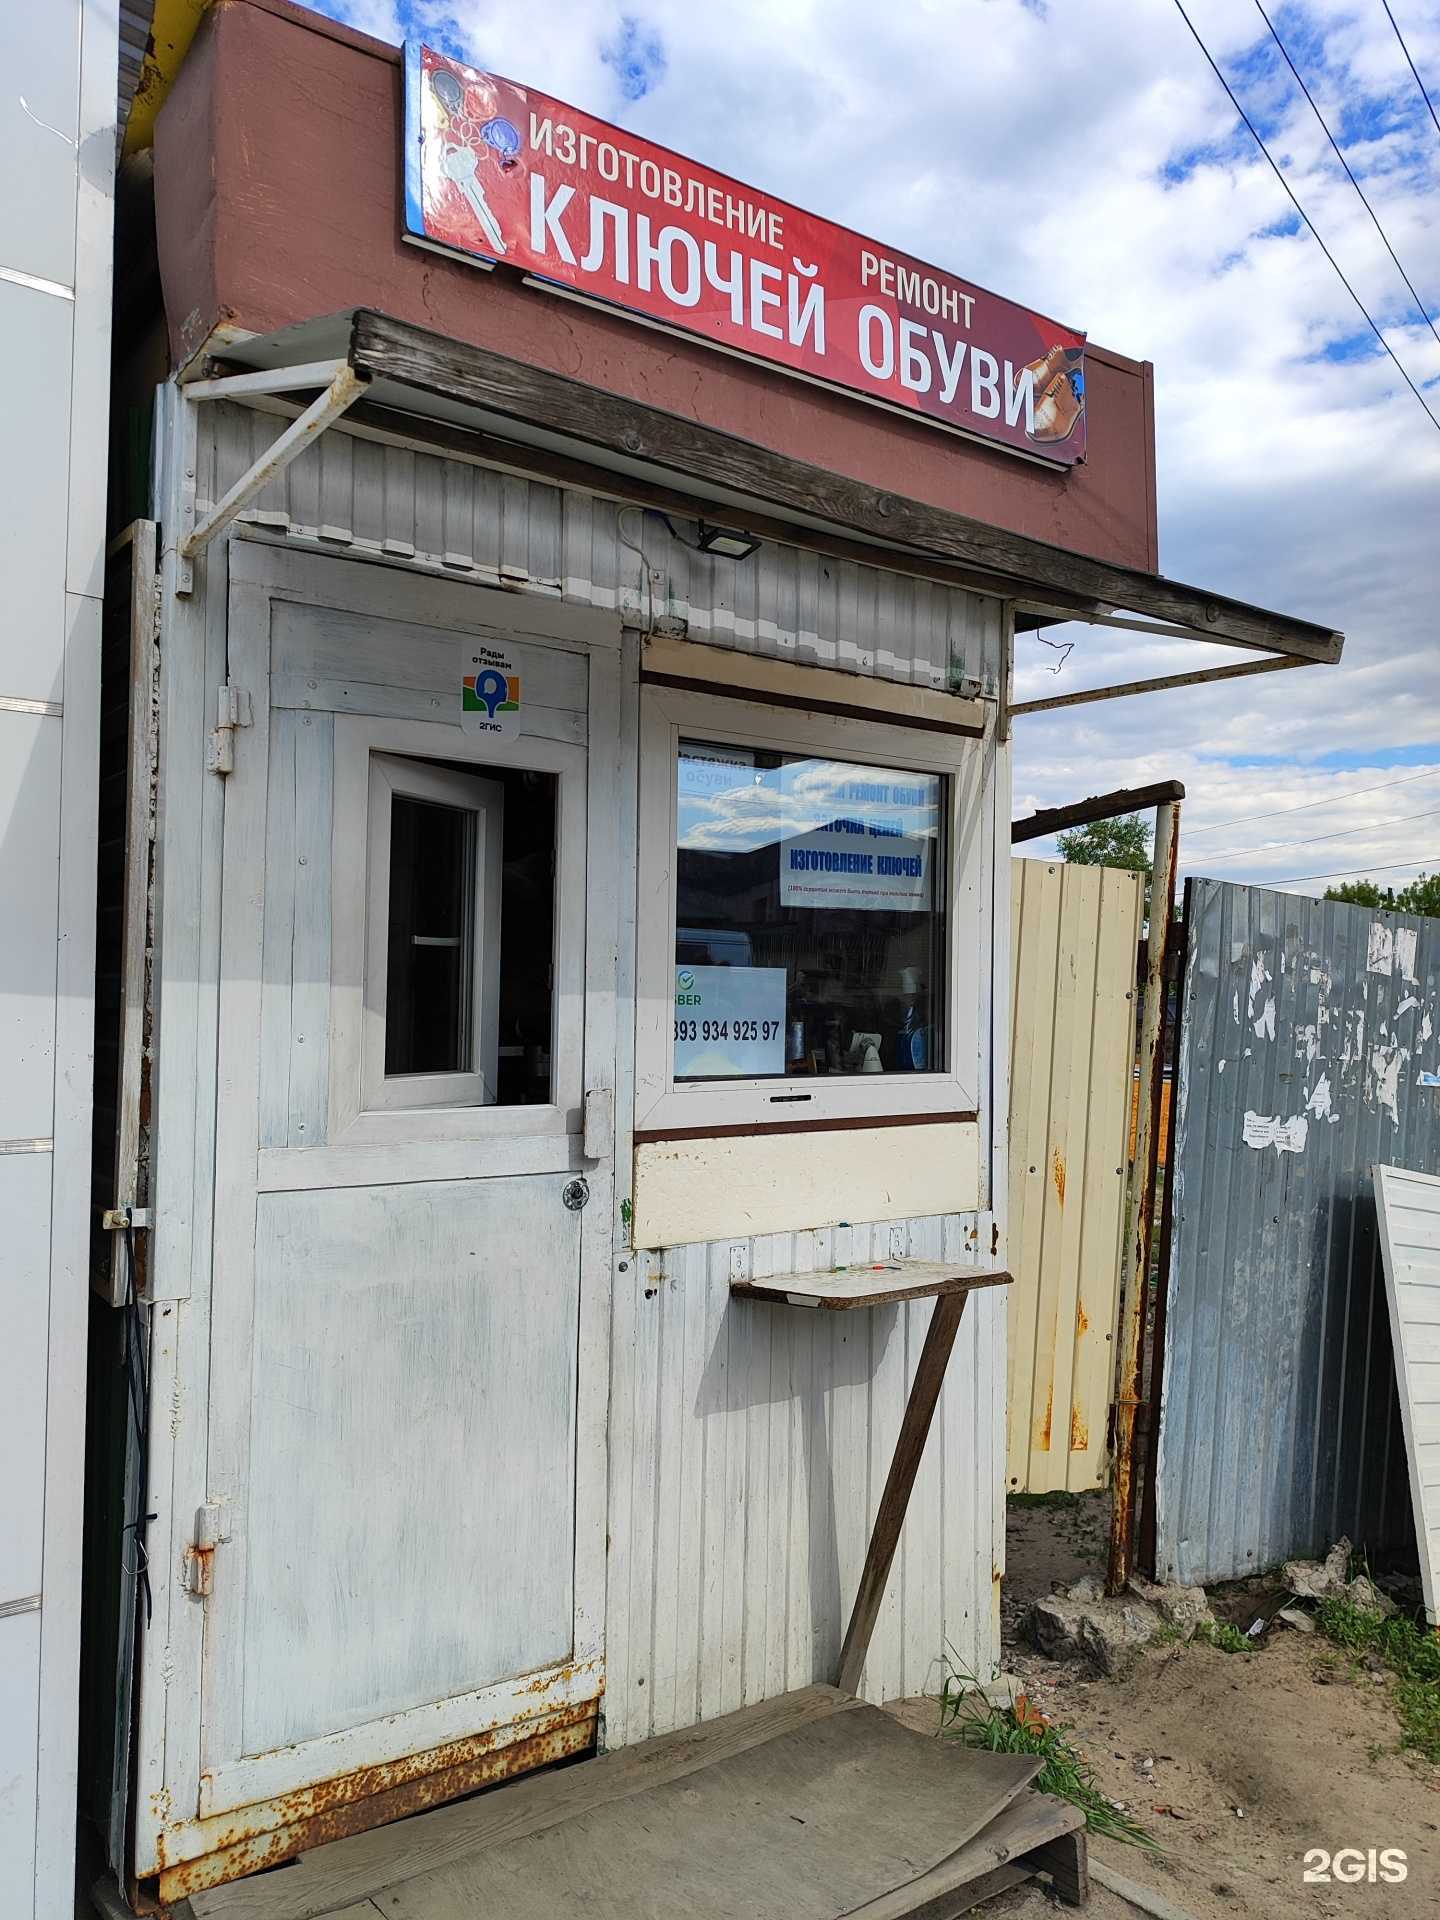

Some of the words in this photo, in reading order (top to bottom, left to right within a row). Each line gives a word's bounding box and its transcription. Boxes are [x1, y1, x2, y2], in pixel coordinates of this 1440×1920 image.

[529, 112, 784, 250] ИЗГОТОВЛЕНИЕ
[529, 173, 826, 356] КЛЮЧЕЙ
[861, 250, 976, 329] РЕМОНТ
[858, 303, 1036, 435] ОБУВИ
[472, 656, 512, 670] отзывам
[480, 647, 505, 659] Рады
[479, 722, 503, 732] 2ГИС
[790, 849, 873, 874] ИЗГОТОВЛЕНИЕ
[877, 855, 922, 877] КЛЮЧЕЙ
[702, 1021, 728, 1041] 934
[733, 1021, 758, 1041] 925
[762, 1021, 780, 1040] 97
